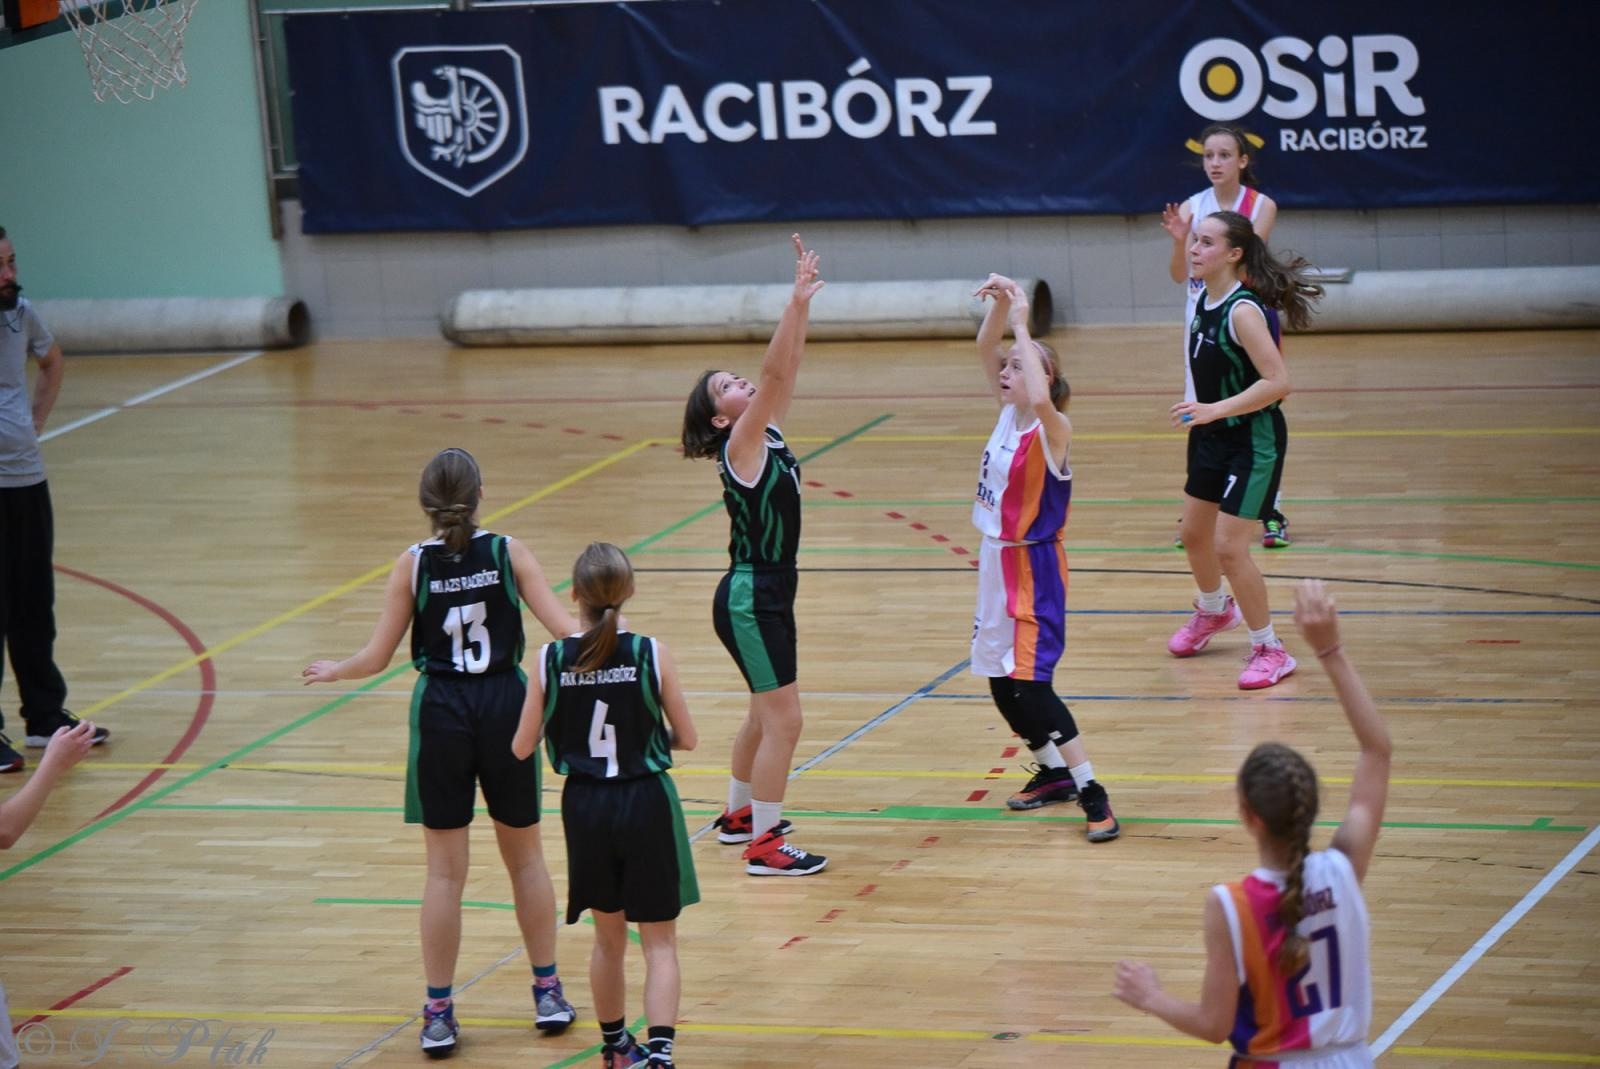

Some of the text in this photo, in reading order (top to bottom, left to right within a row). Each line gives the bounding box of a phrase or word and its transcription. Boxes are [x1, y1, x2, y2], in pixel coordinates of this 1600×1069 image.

[598, 57, 998, 144] RACIBÓRZ
[1179, 34, 1426, 121] OSiR
[1280, 120, 1428, 151] RACIBÓRZ
[1223, 474, 1238, 499] 7
[442, 601, 491, 674] 13
[597, 664, 637, 684] RACIBÓRZ
[588, 699, 619, 778] 4
[1286, 924, 1342, 1019] 27
